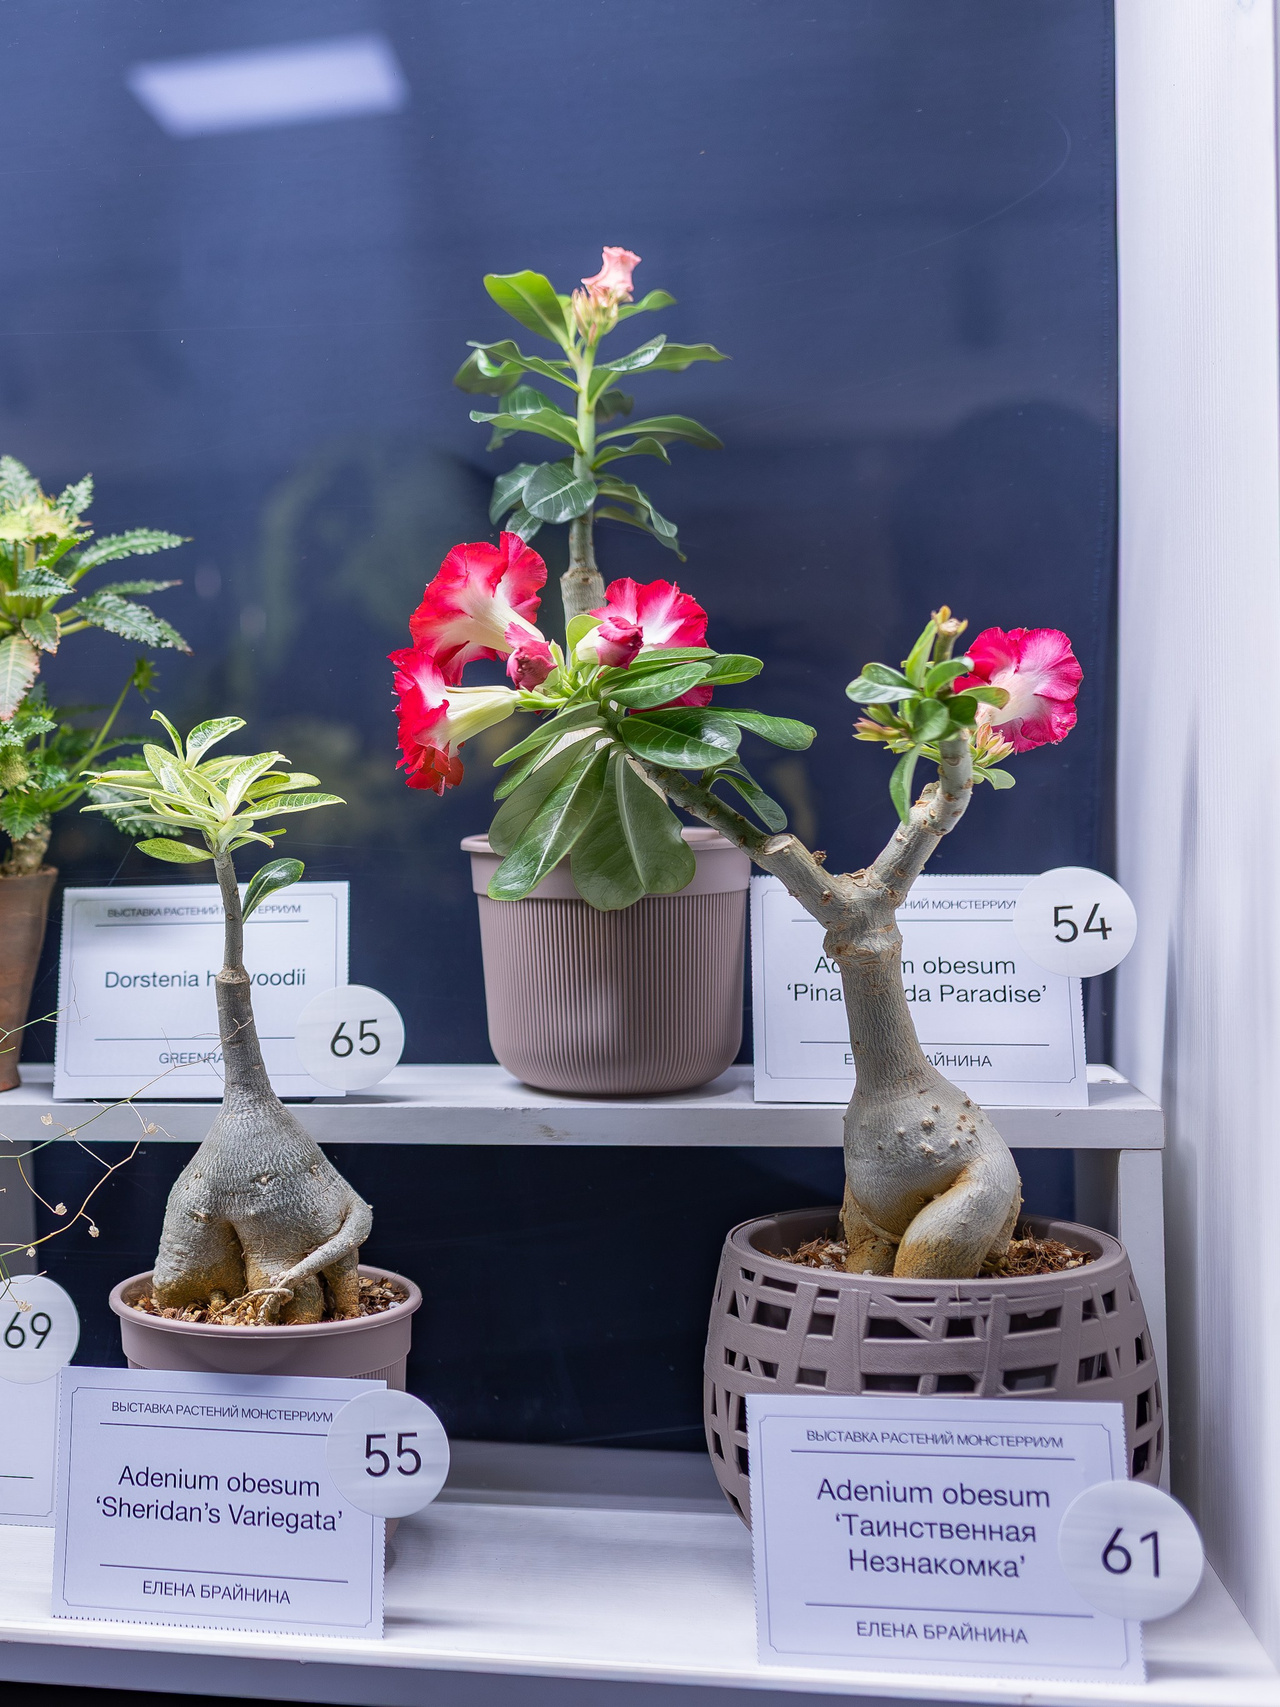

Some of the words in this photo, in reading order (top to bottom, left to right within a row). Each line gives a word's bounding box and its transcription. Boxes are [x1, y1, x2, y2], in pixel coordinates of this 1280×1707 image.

[107, 907, 163, 918] ВЫСТАВКА
[165, 904, 220, 917] РАСТЕНИЙ
[931, 900, 1017, 910] МОНСТЕРРИУ
[1053, 903, 1112, 943] 54
[922, 956, 1016, 974] obesum
[104, 971, 199, 989] Dorstenia
[939, 984, 1048, 1004] Paradise’
[330, 1018, 381, 1058] 65
[3, 1312, 52, 1350] 69
[111, 1401, 174, 1416] ВЫСТАВКА
[175, 1403, 239, 1420] РАСТЕНИЙ
[241, 1408, 334, 1424] МОНСТЕРРИУМ
[806, 1430, 879, 1444] ВЫСТАВКА
[881, 1430, 954, 1447] РАСТЕНИЙ
[957, 1434, 1063, 1449] МОНСТЕРРИУМ
[364, 1432, 422, 1477] 55
[118, 1465, 219, 1491] Adenium
[226, 1472, 320, 1497] obesum
[817, 1478, 933, 1504] Adenium
[942, 1482, 1050, 1508] obesum
[96, 1496, 221, 1524] ‘Sheridan’s
[228, 1504, 343, 1535] Variegata’
[835, 1513, 1037, 1543] ‘Таинственная
[849, 1550, 1025, 1578] Незнакомка’
[1101, 1526, 1160, 1578] 61
[142, 1580, 197, 1598] ЕЛЕНА
[200, 1582, 291, 1605] БРАЙНИНА
[856, 1621, 918, 1639] ЕЛЕНА
[923, 1622, 1029, 1645] БРАЙНИНА
